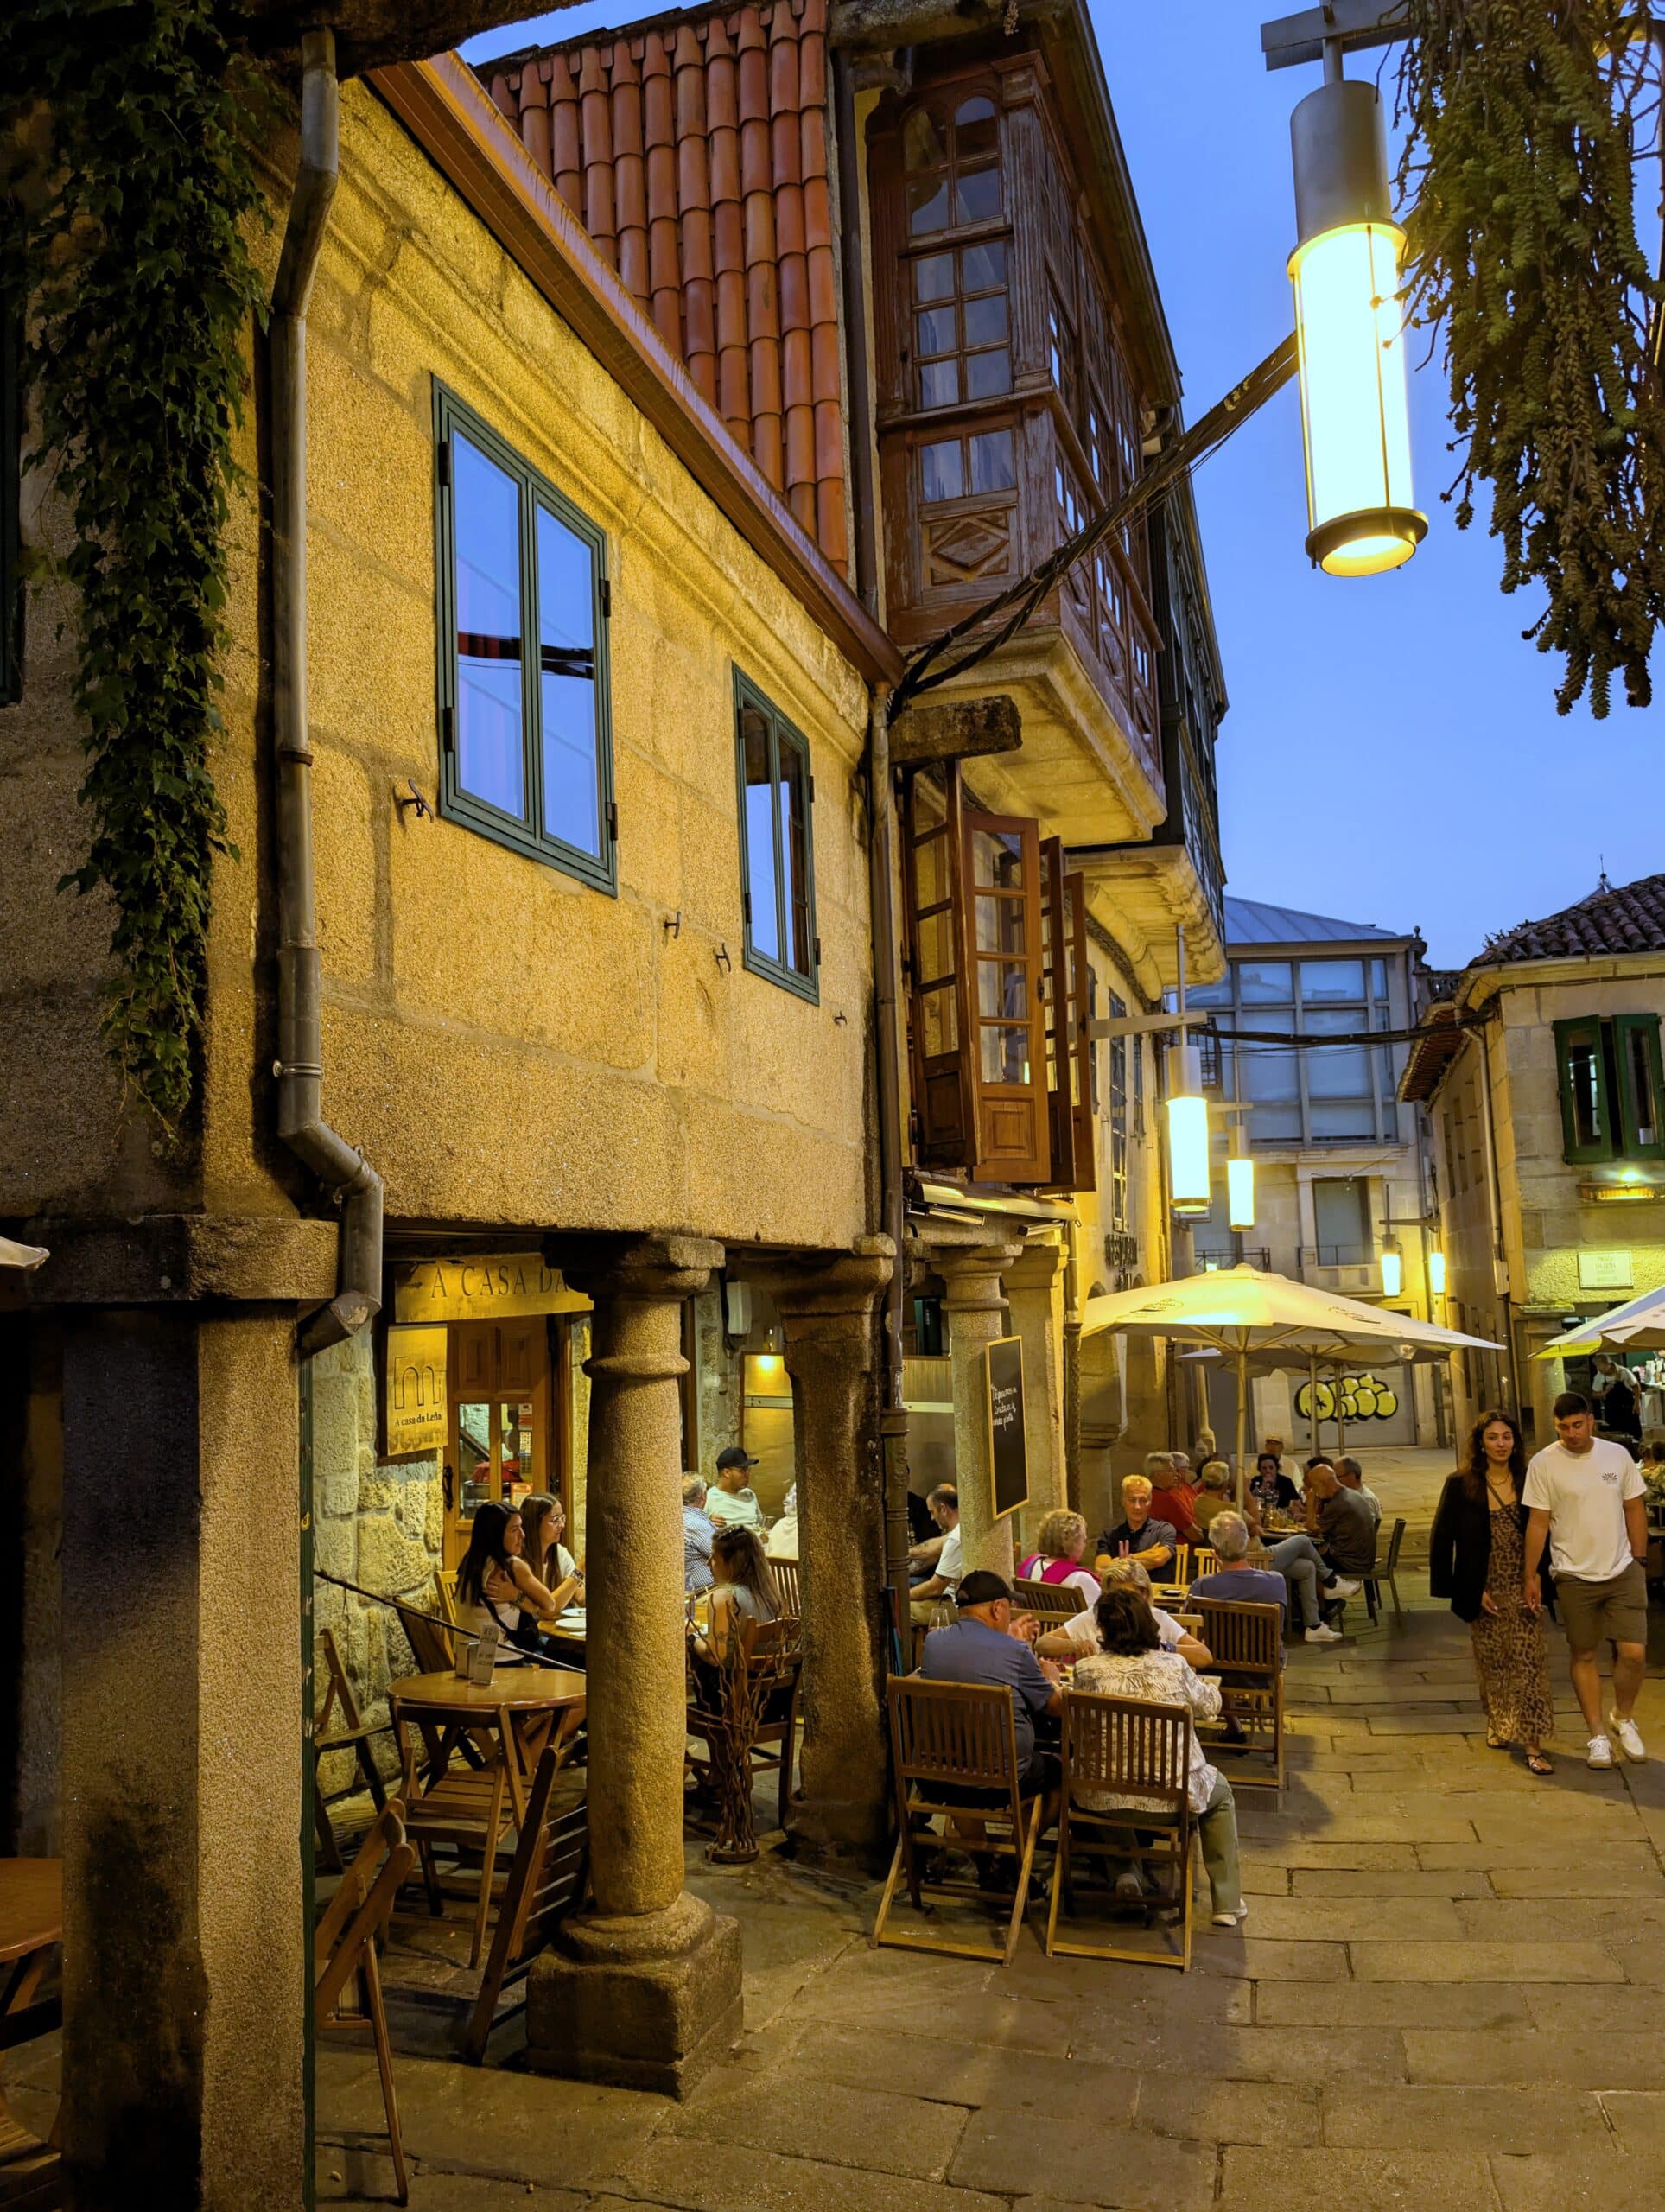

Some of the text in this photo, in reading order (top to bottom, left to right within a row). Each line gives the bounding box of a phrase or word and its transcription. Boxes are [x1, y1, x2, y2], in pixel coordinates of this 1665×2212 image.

[431, 1266, 447, 1298] A
[461, 1265, 527, 1296] CASA
[401, 1416, 416, 1426] casa
[416, 1414, 426, 1424] da
[427, 1411, 442, 1422] Leña
